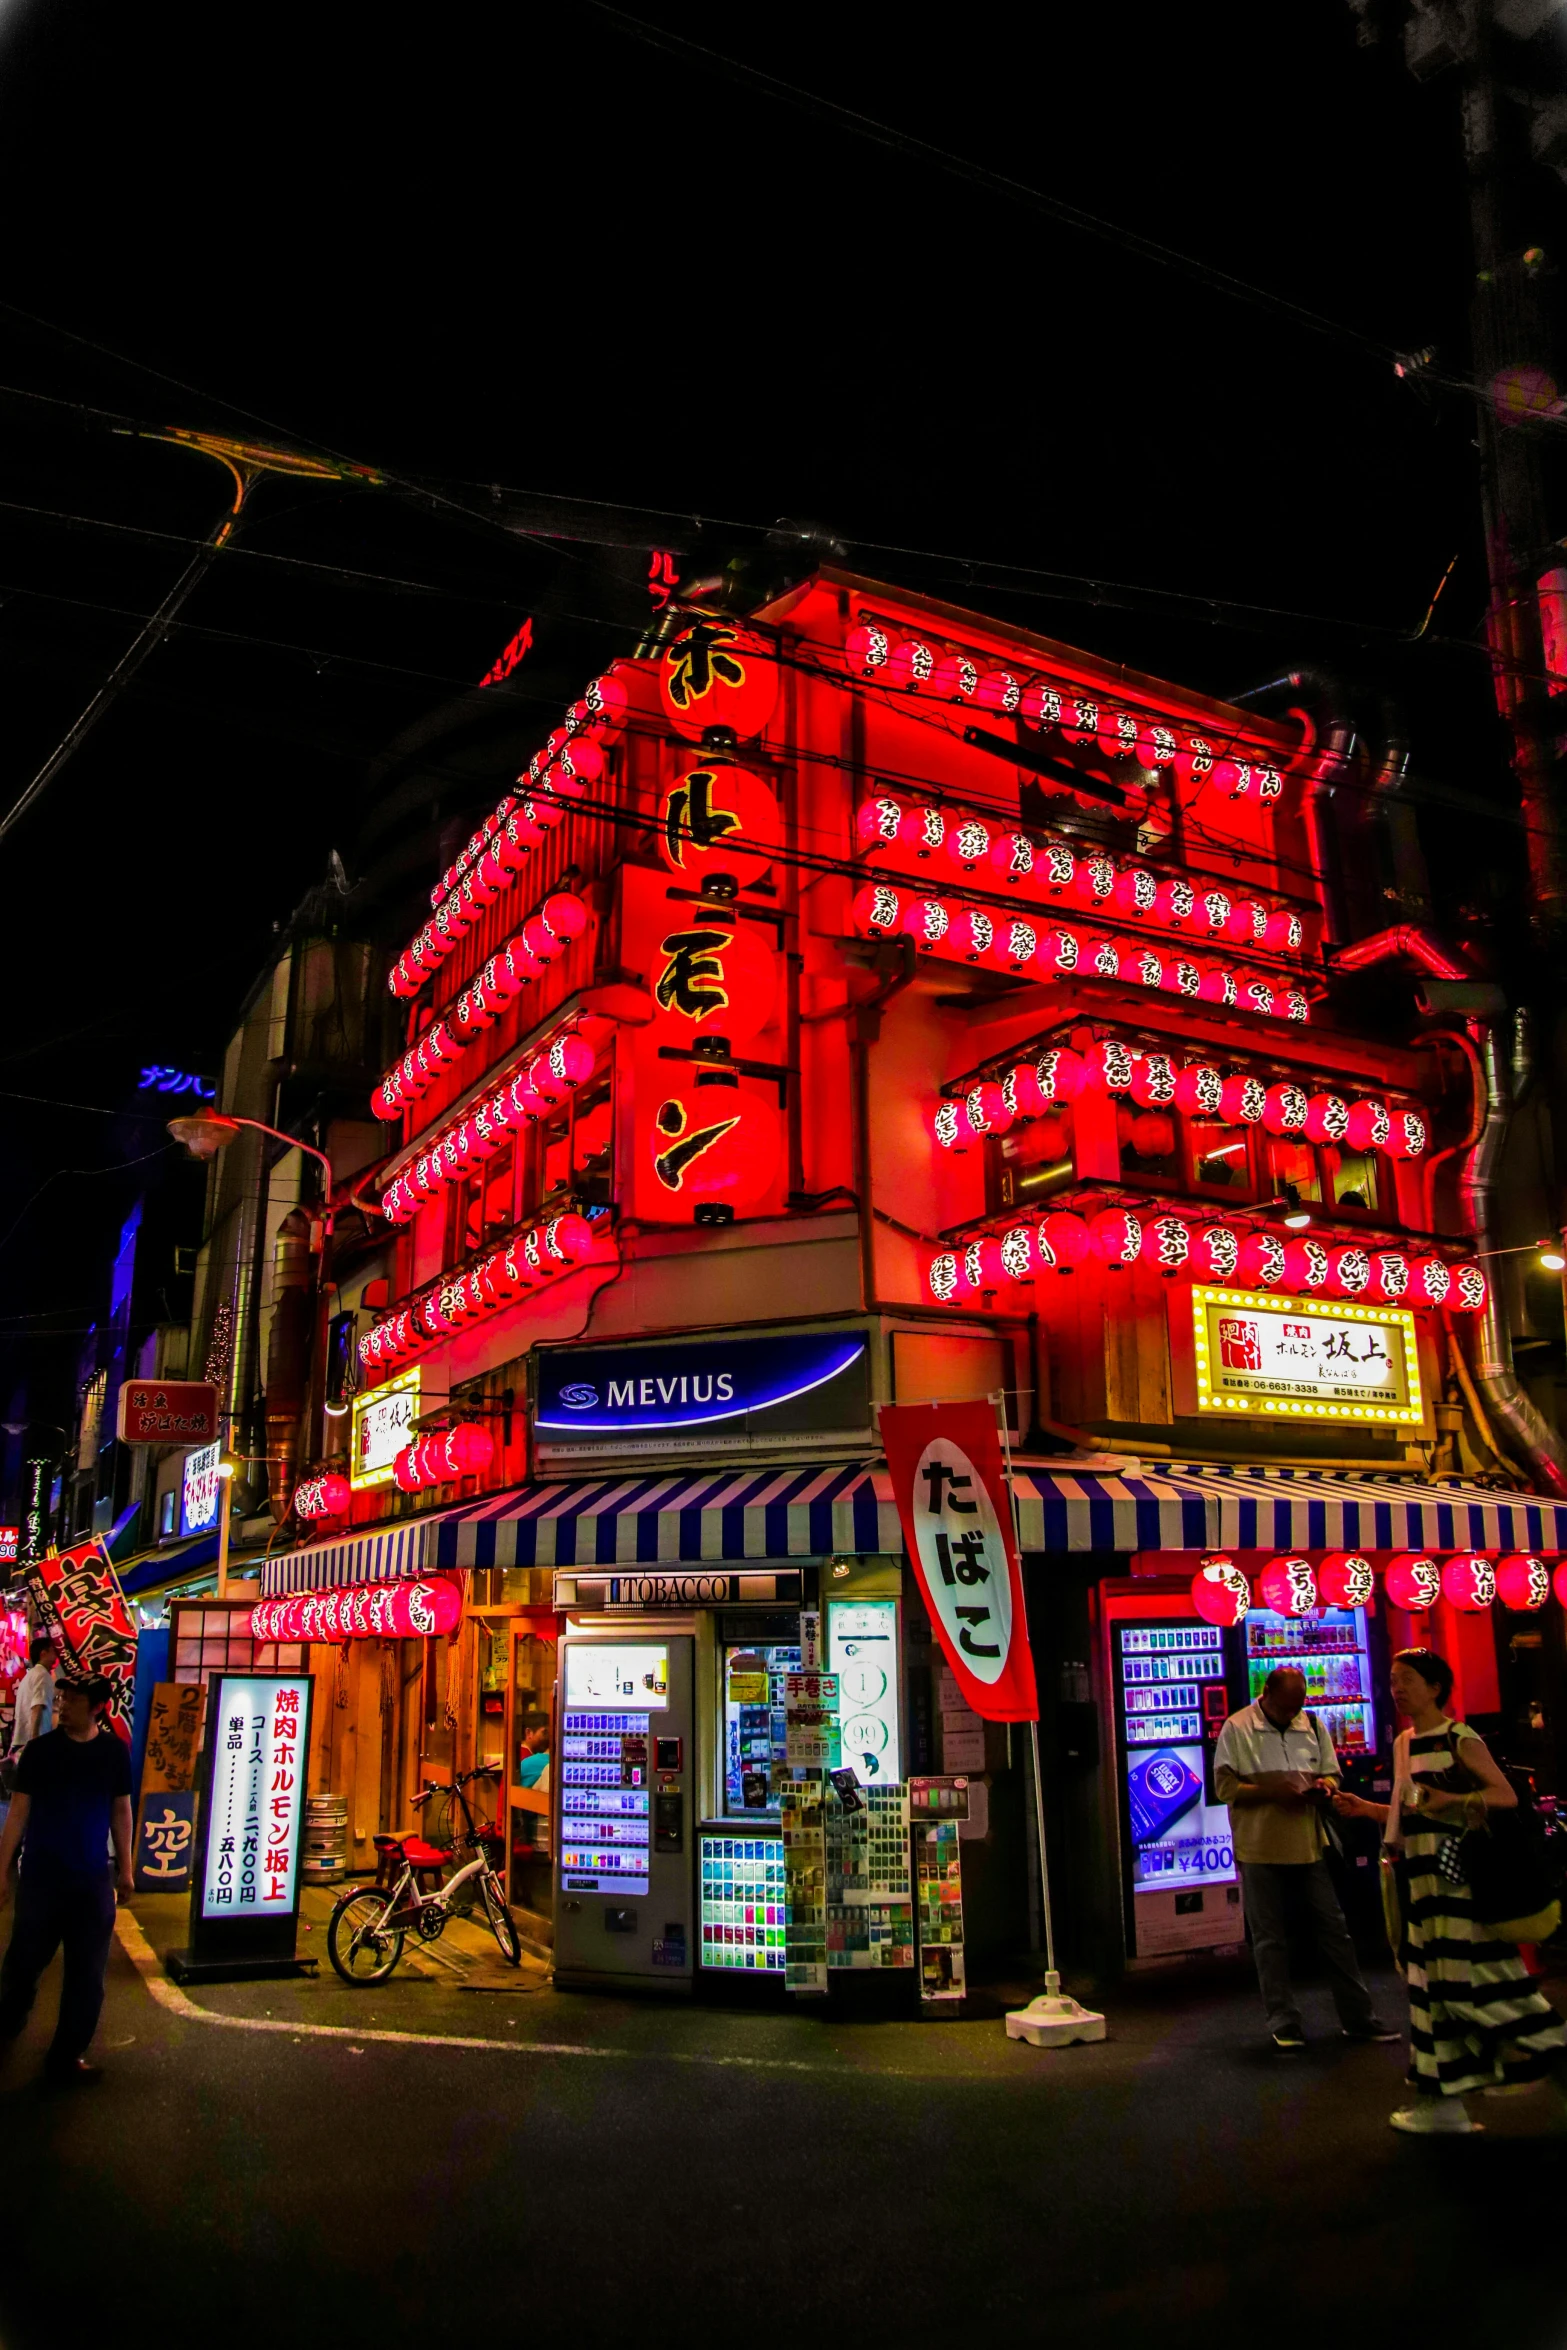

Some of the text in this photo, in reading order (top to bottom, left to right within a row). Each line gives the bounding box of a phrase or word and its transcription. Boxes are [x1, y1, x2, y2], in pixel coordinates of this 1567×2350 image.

[1148, 1054, 1176, 1101] また来てや
[1154, 1218, 1189, 1266] せやかて
[1203, 1228, 1238, 1276] 飲んでって
[1286, 1325, 1309, 1338] 焼肉
[1276, 1330, 1387, 1363] ホルモン 坂上
[132, 1391, 169, 1410] 活魚
[607, 1373, 734, 1407] MEVIUS
[139, 1411, 210, 1434] 炉ばた焼
[922, 1461, 1002, 1658] たばこ
[622, 1576, 728, 1602] TOBACCO
[787, 1677, 837, 1699] 手巻き
[853, 1725, 876, 1745] 99
[1150, 1769, 1173, 1794] STRIKE
[1158, 1763, 1181, 1786] LUCKY
[262, 1688, 300, 1902] 焼肉ホルモン坂上
[141, 1808, 192, 1878] 空
[1178, 1846, 1234, 1873] ¥400
